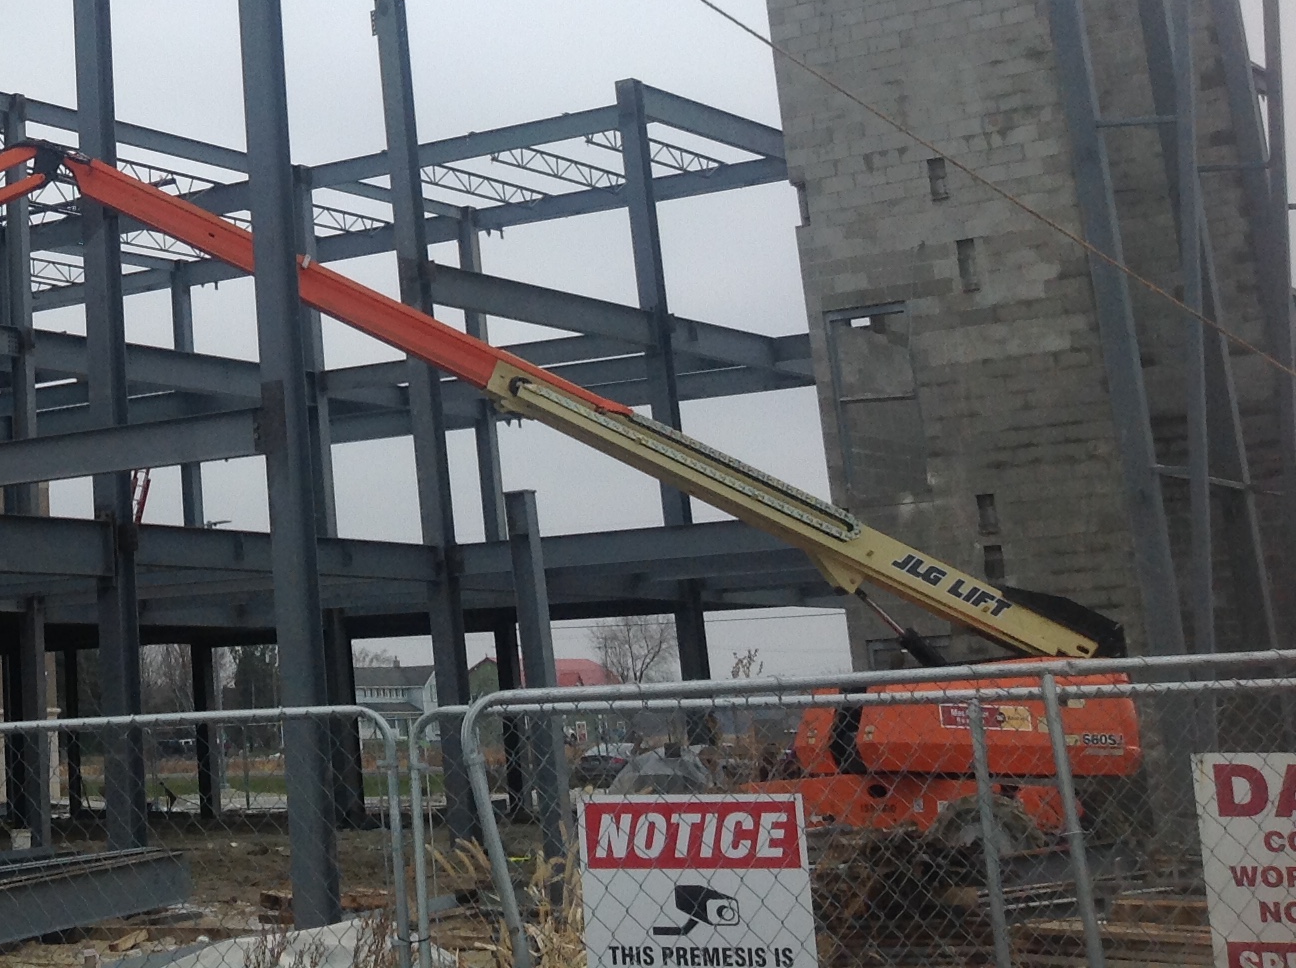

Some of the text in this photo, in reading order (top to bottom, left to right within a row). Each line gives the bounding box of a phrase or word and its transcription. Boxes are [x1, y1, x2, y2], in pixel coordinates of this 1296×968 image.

[891, 553, 1013, 617] JLG LIFT
[595, 811, 788, 859] NOTICE
[609, 946, 794, 967] THIS PREMESIS IS
